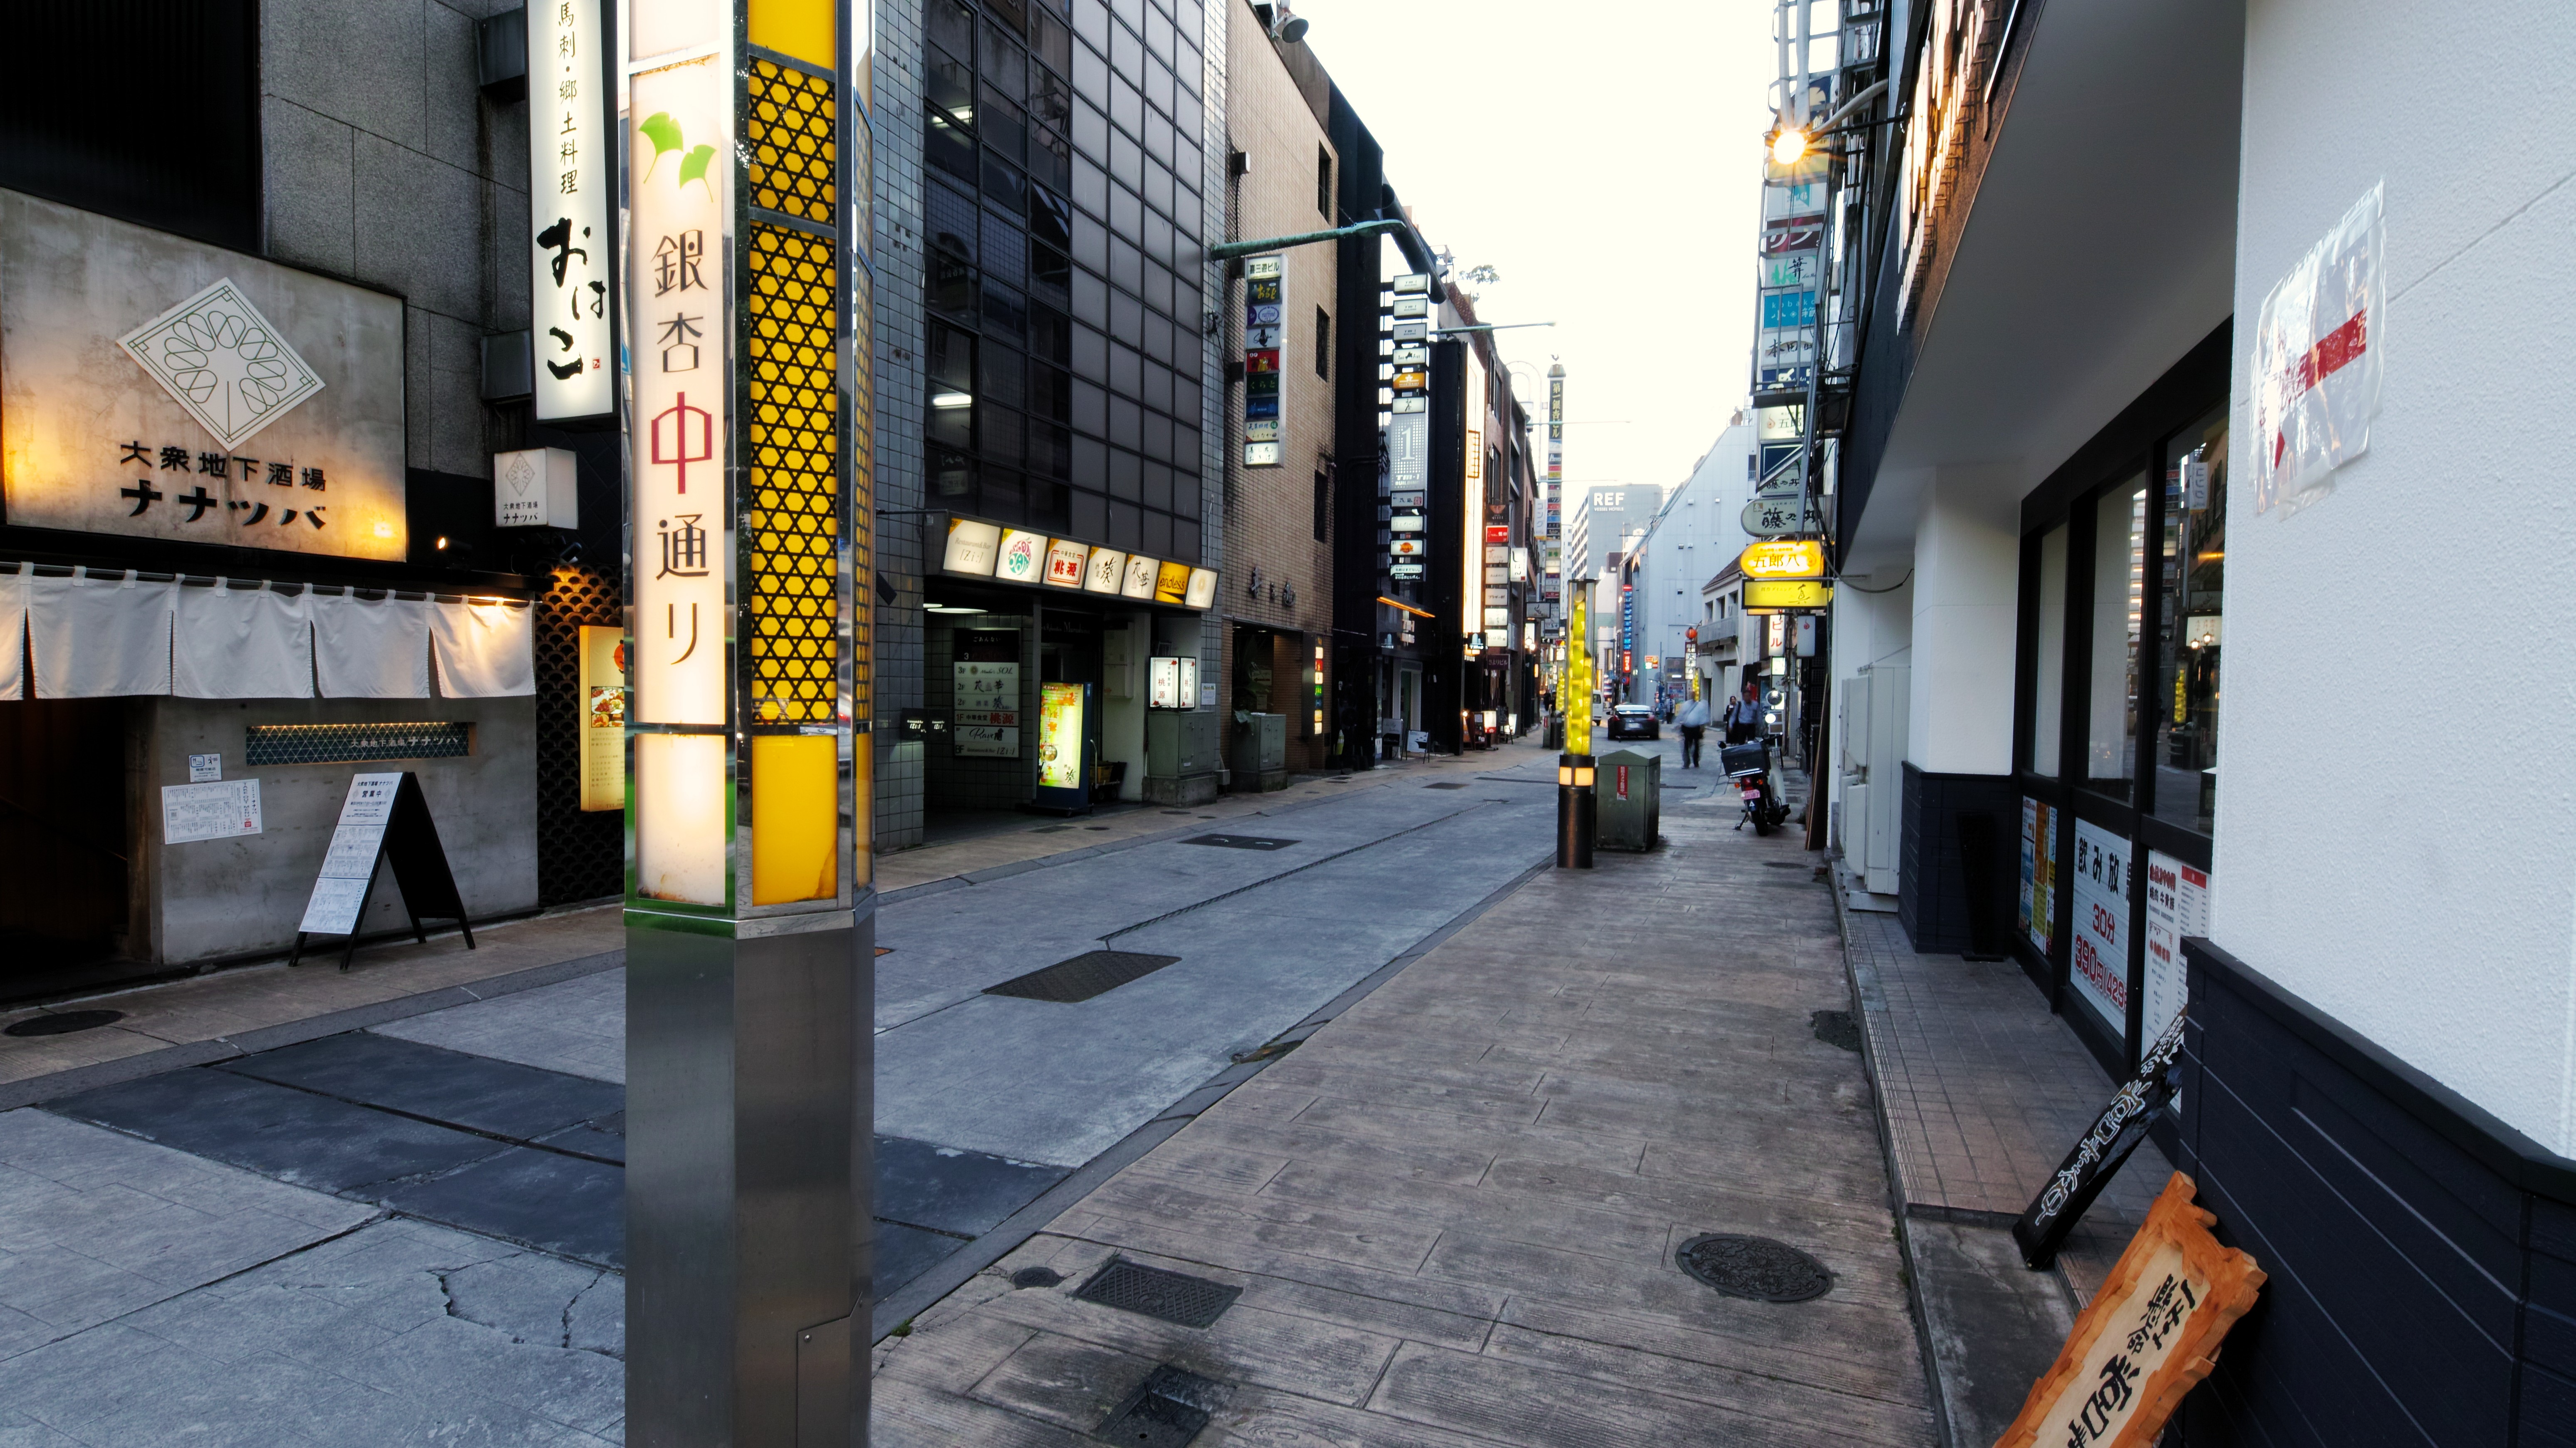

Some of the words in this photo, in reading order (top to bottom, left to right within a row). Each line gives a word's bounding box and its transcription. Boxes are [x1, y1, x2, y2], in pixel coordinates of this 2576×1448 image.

[557, 2, 578, 195] 馬刺・郷土料理
[651, 230, 713, 665] 銀杏中通り
[120, 441, 327, 492] 大衆地下酒場
[121, 480, 327, 530] ナナツバ
[503, 501, 538, 511] 大衆地下酒場
[1594, 493, 1625, 506] REF
[503, 512, 538, 525] ナナツバ
[1054, 559, 1077, 578] 桃源
[1752, 553, 1800, 569] 五郎八
[1159, 575, 1185, 590] endless
[1771, 620, 1783, 647] ビル
[1158, 678, 1166, 699] 桃源
[990, 712, 1014, 725] 桃源
[351, 737, 406, 749] 大衆地下酒場
[408, 735, 459, 747] ナナツバ
[362, 790, 382, 798] 営業中
[2093, 903, 2115, 945] 30分
[2075, 934, 2127, 1014] 390円(429
